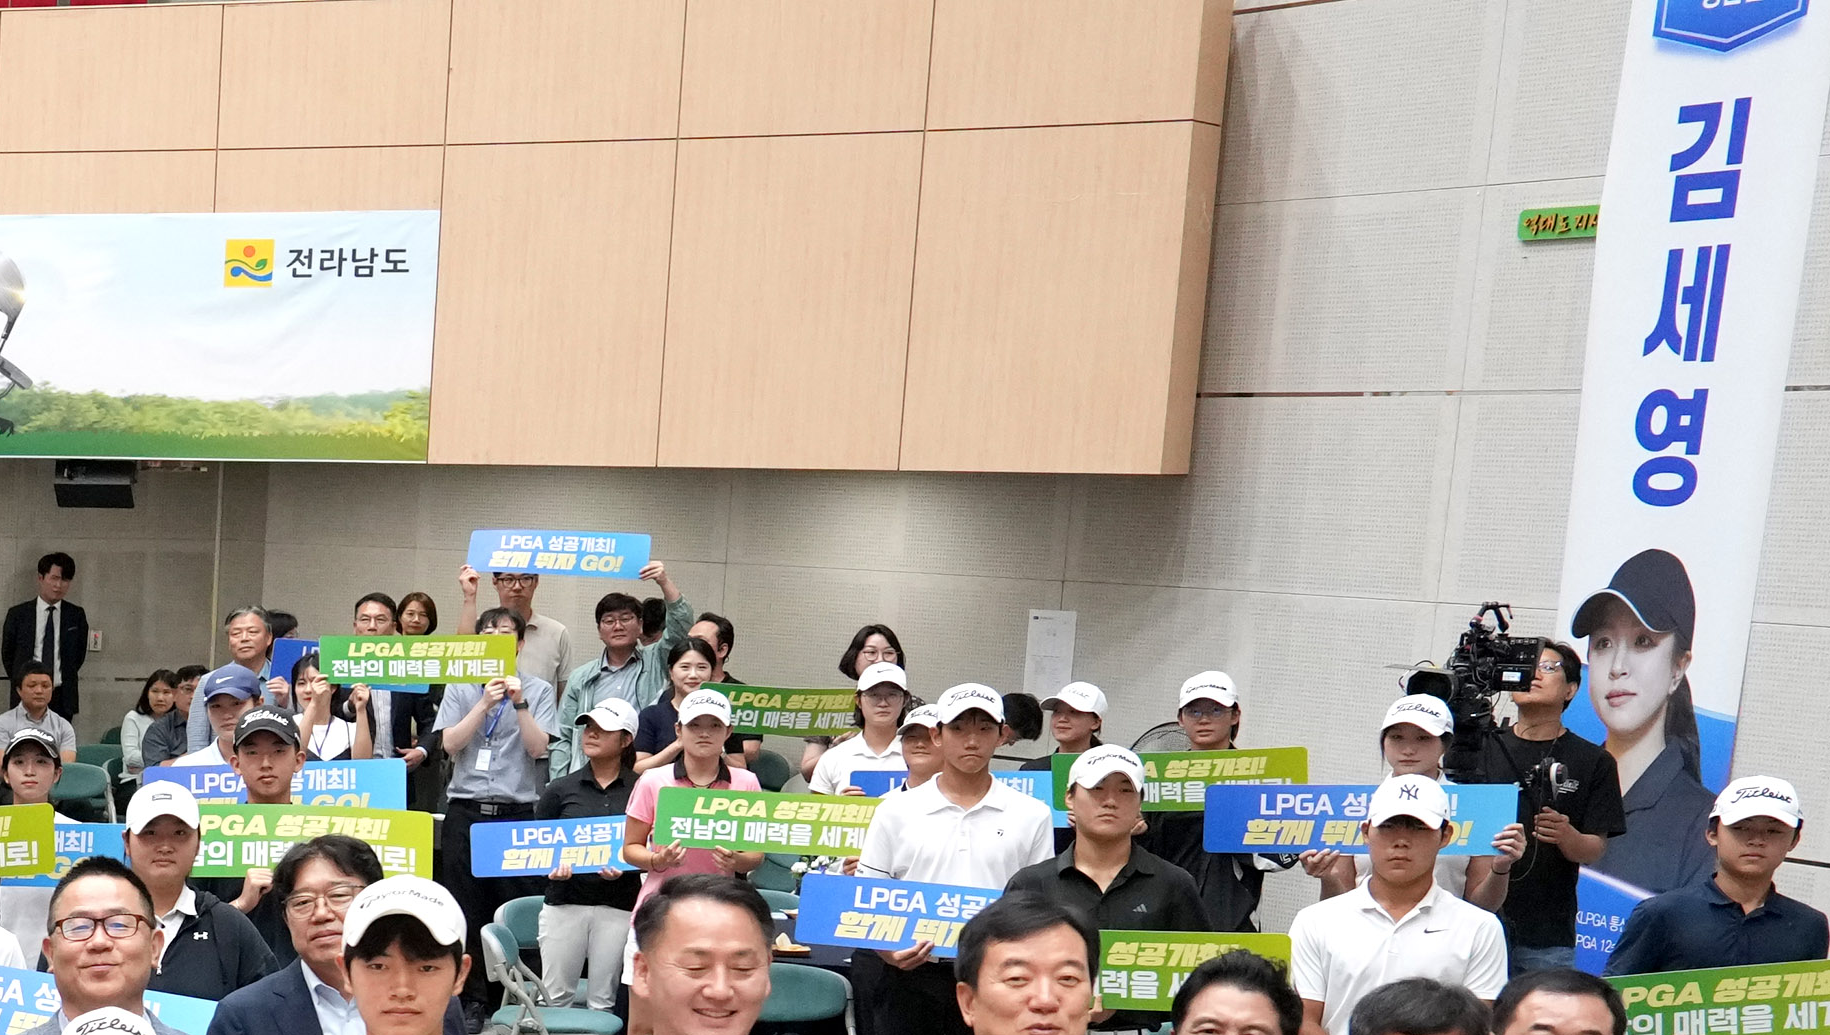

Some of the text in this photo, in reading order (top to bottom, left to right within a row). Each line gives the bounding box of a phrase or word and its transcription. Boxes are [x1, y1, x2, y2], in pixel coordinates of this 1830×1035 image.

[285, 245, 411, 280] 전라남도
[500, 535, 616, 553] LPGA 성공개최!
[488, 551, 624, 572] 함께 뛰자 GO!
[348, 640, 488, 657] LPGA 성공개최!
[331, 659, 504, 679] 전남의 매력을 세계로!
[785, 694, 854, 712] 성공개최!
[947, 689, 997, 708] Titleist
[1734, 785, 1794, 805] Titleist
